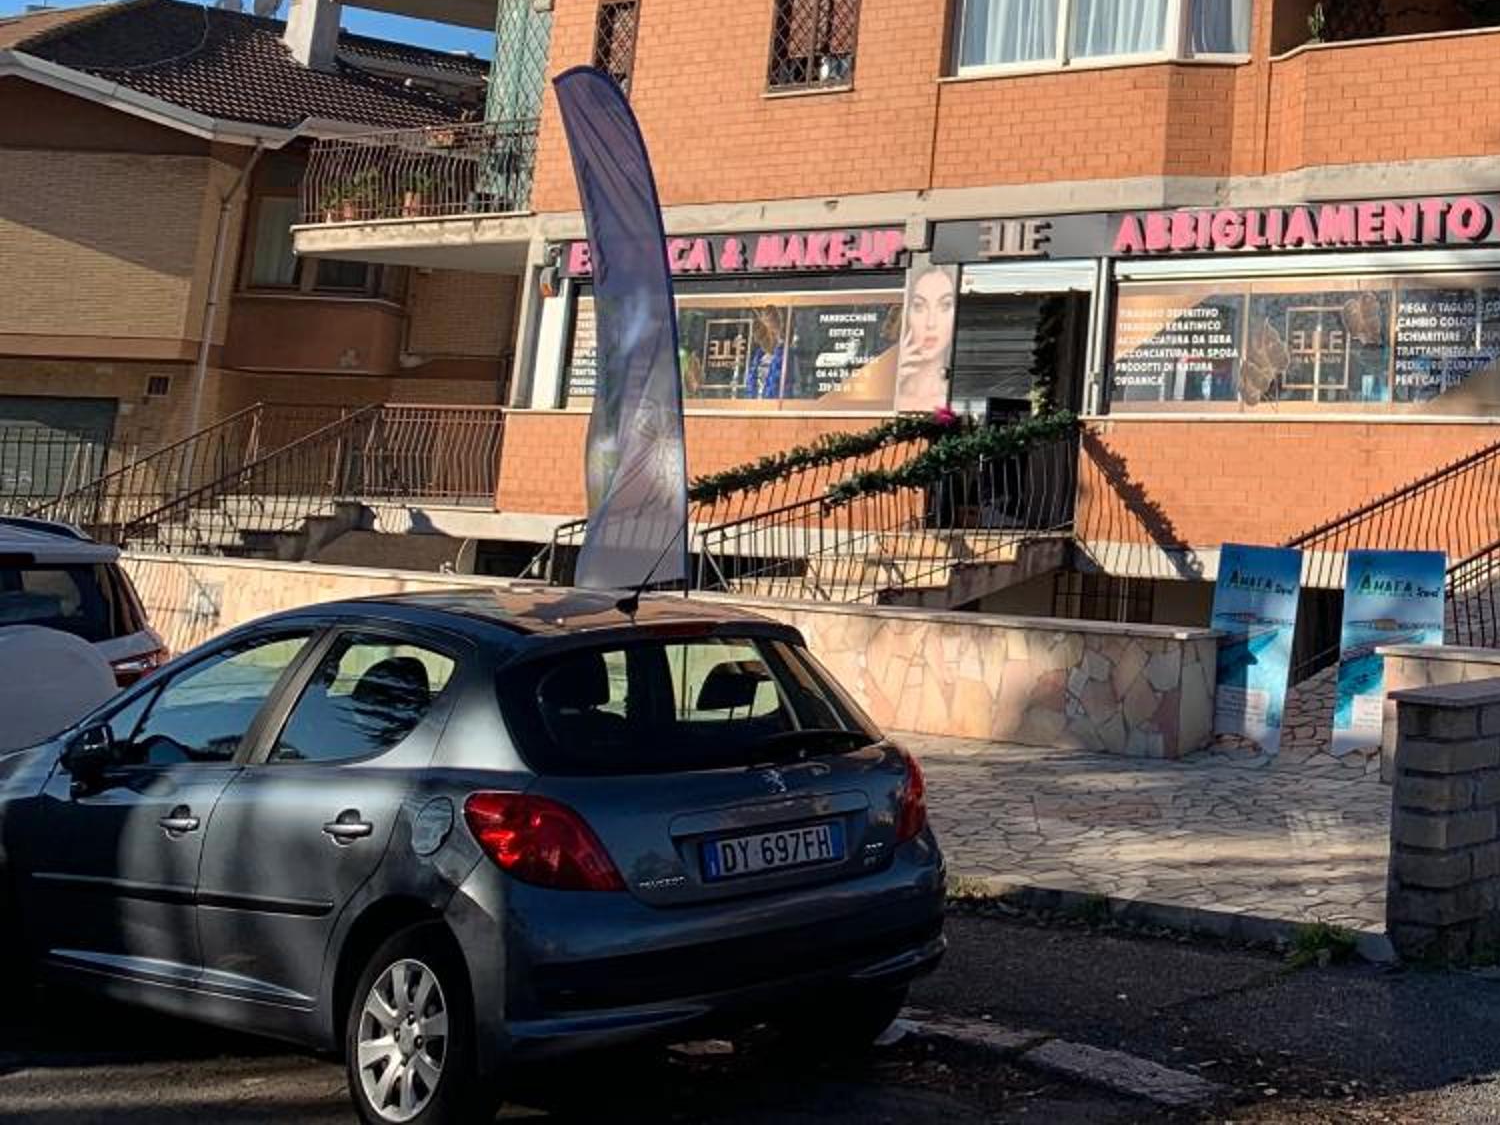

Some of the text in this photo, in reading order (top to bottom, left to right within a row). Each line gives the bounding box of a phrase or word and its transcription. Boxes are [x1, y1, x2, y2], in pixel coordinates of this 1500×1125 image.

[1113, 196, 1488, 252] ABBIGLIAMENTO
[753, 230, 902, 269] MAKE-UP
[721, 838, 750, 874] DY
[760, 825, 833, 866] 697FH
